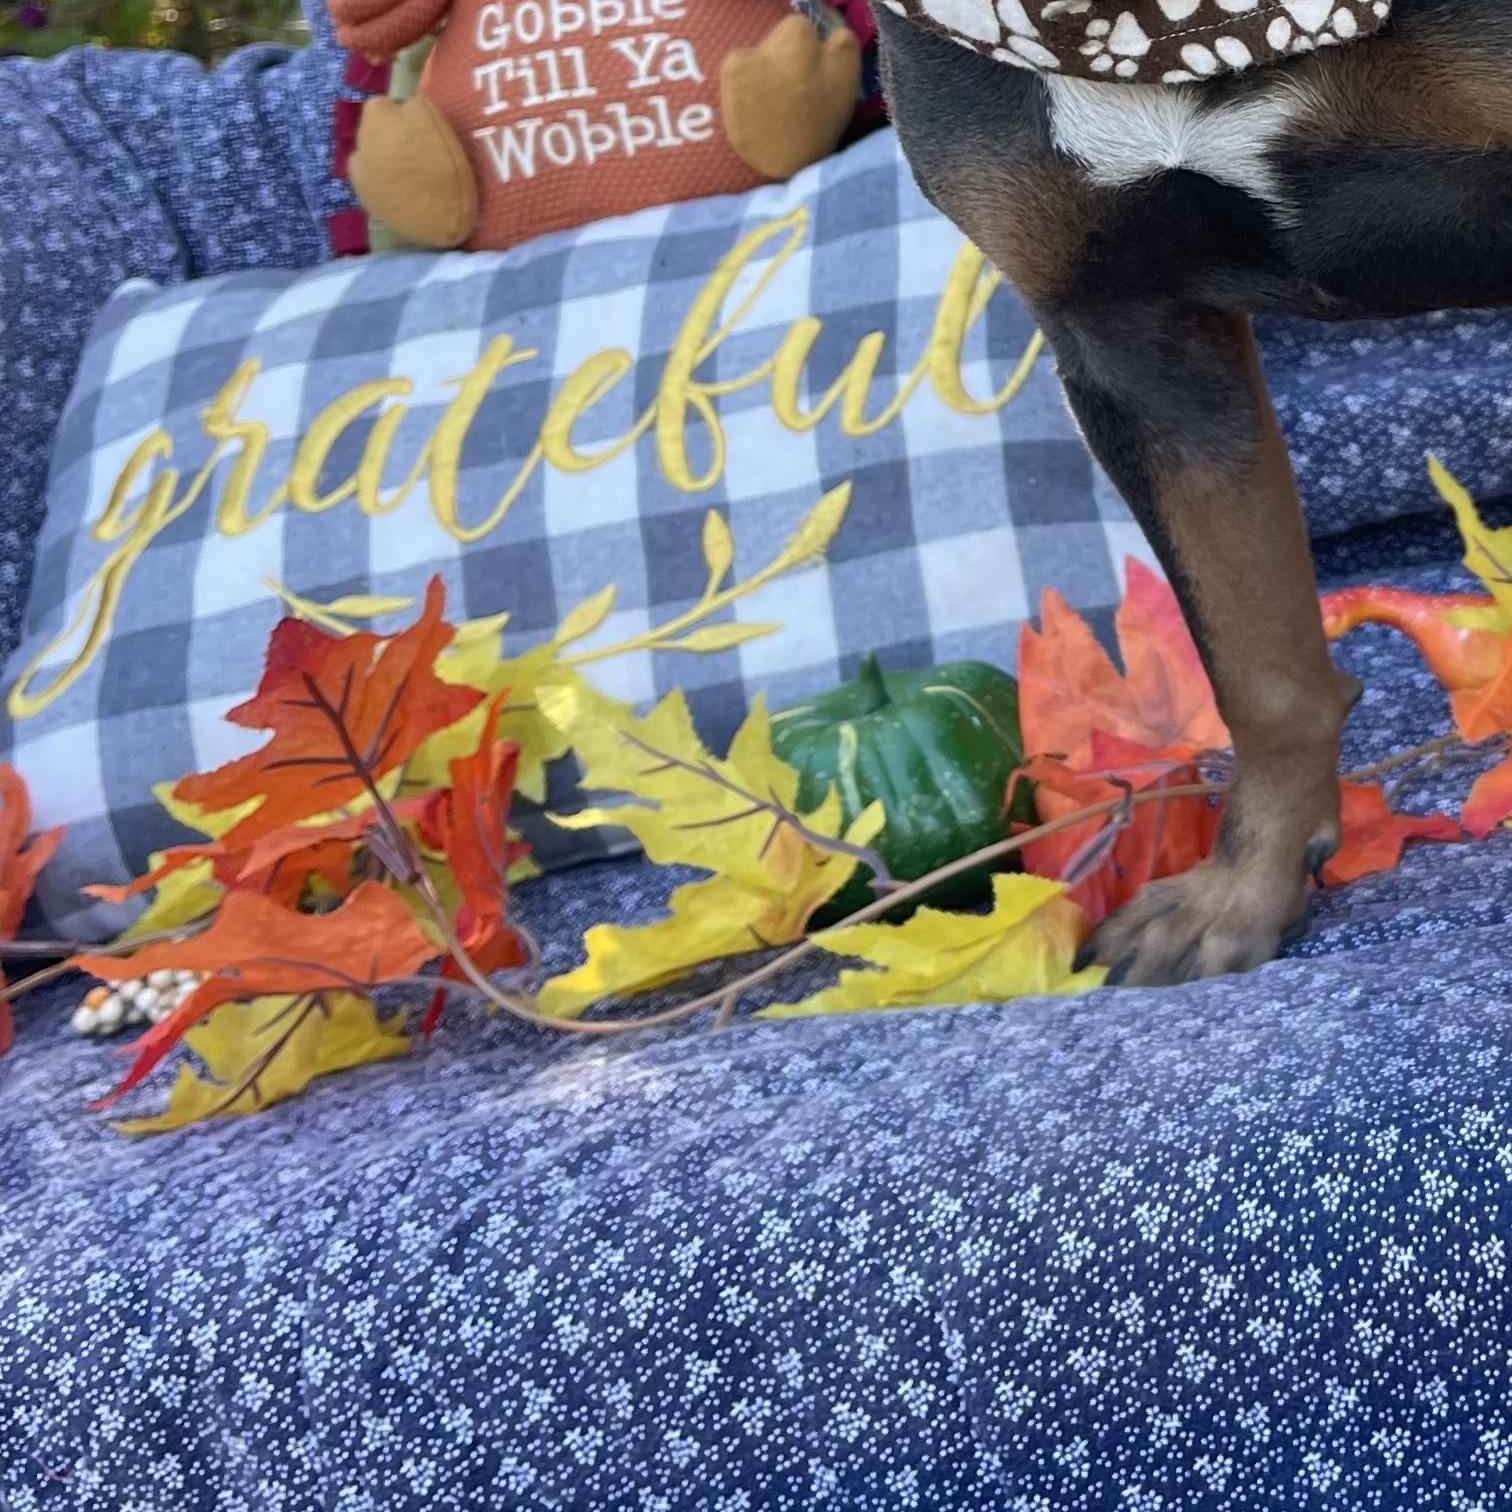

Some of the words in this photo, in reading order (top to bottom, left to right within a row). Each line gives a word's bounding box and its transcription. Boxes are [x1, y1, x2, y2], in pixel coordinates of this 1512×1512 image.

[473, 45, 598, 115] Till
[609, 31, 706, 89] Ya
[472, 94, 716, 184] Wobble
[8, 204, 1043, 719] grateful
